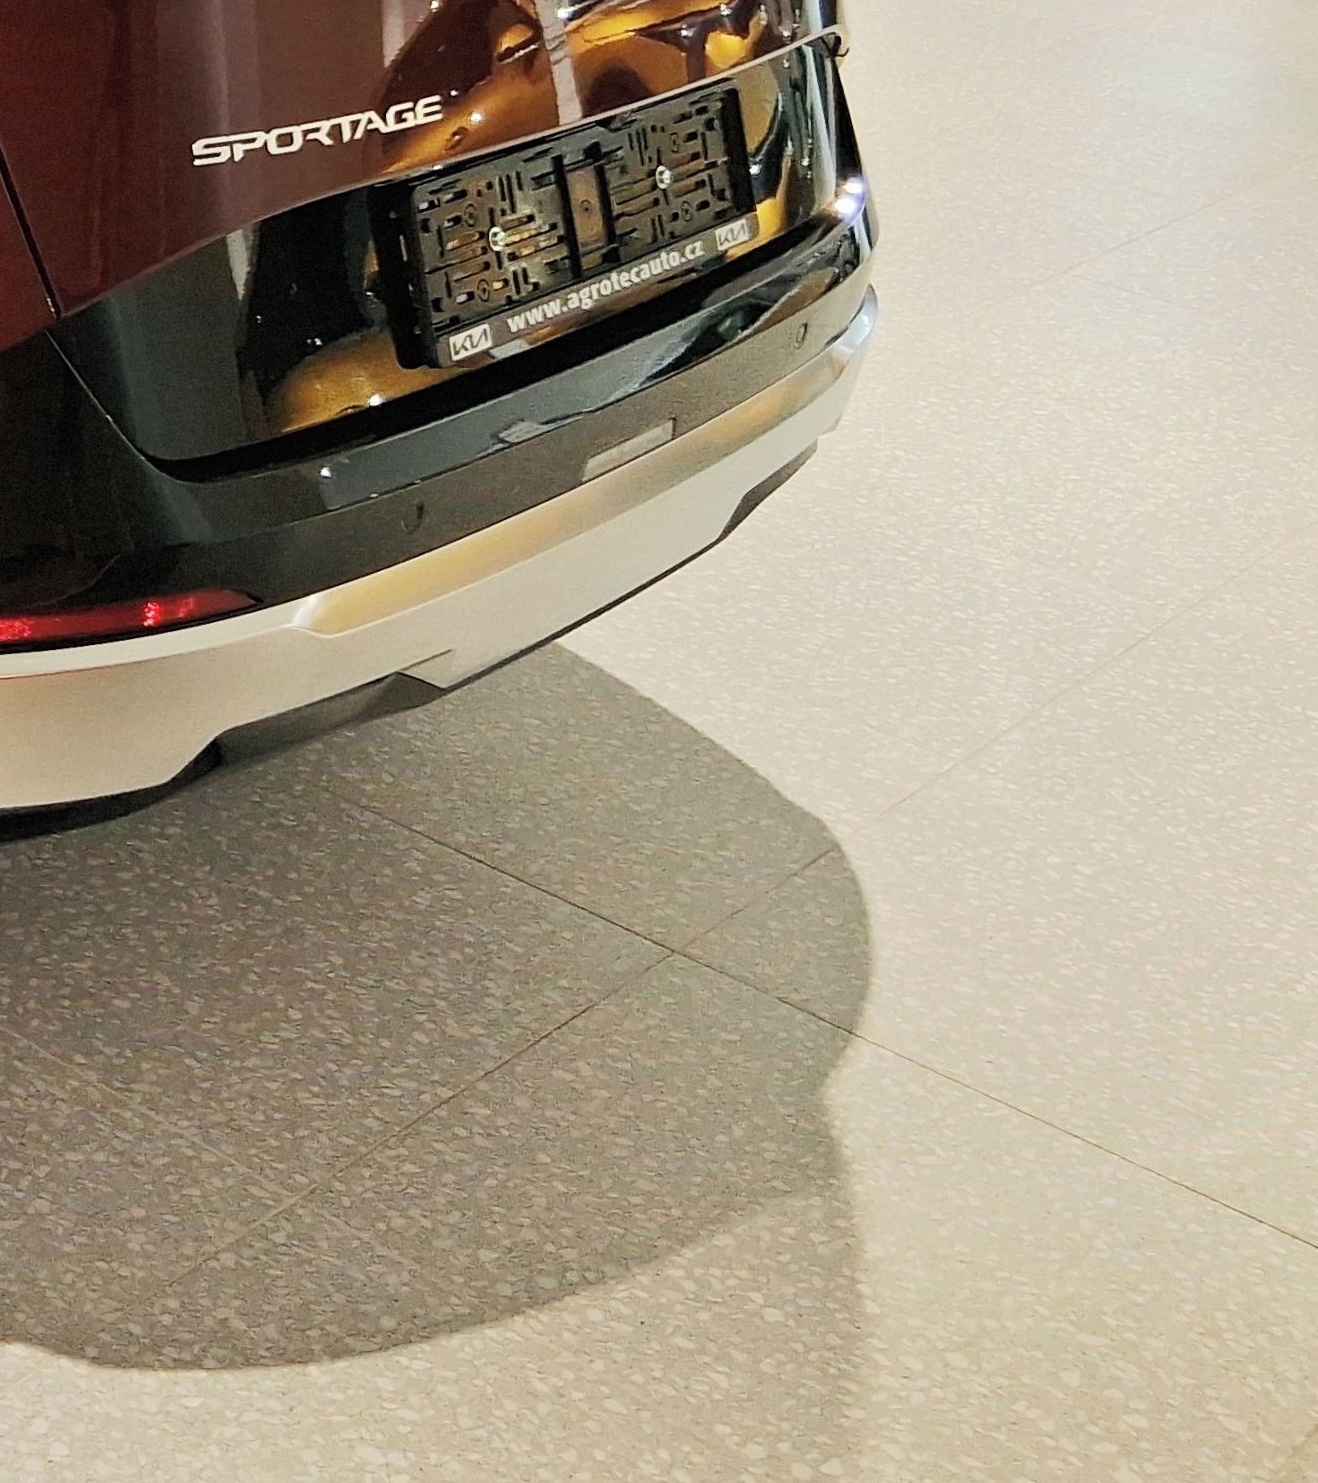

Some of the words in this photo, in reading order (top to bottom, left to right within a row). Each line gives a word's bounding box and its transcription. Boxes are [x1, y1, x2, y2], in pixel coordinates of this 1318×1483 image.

[191, 94, 445, 167] SPORTAGE
[506, 239, 706, 333] www.agrotecauto.cz
[451, 330, 491, 357] KIA
